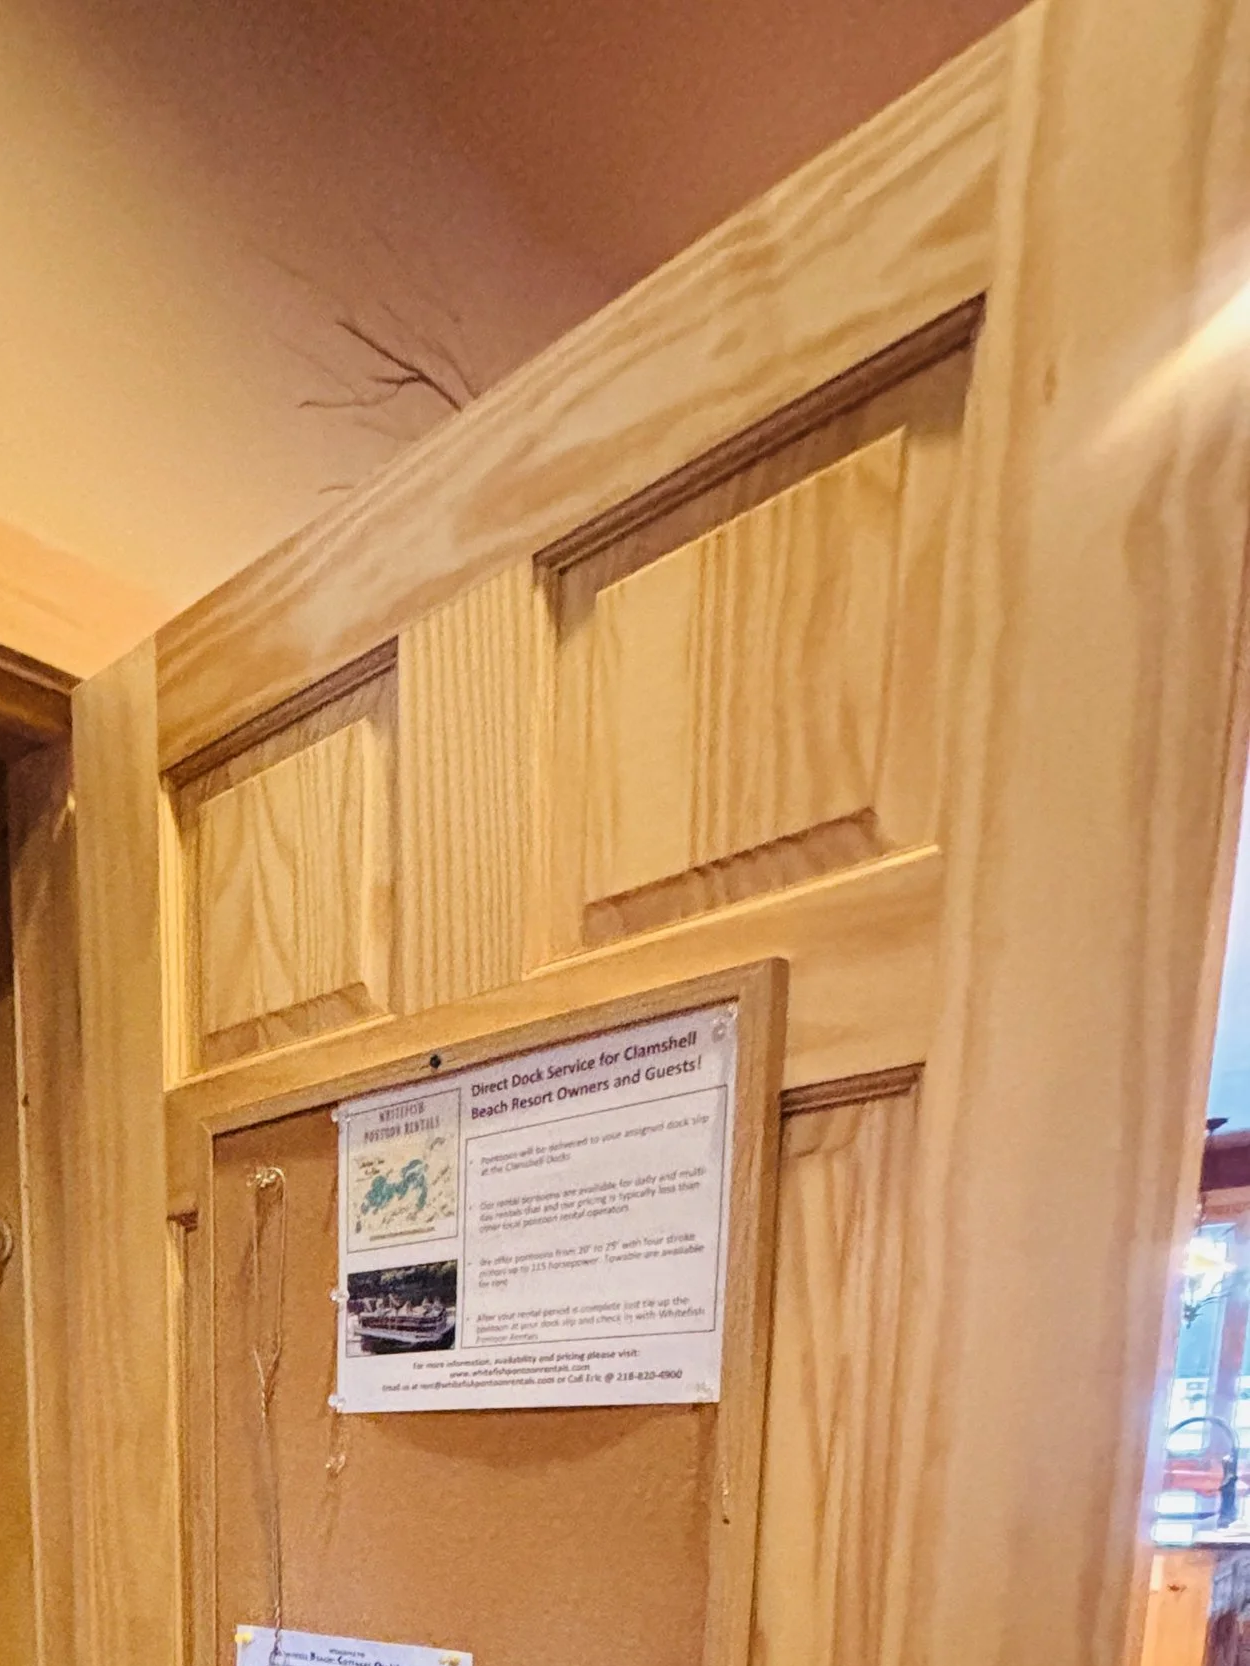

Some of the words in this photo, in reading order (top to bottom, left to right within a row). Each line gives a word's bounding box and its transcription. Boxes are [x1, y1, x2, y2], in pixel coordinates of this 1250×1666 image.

[471, 1079, 508, 1097] Direct
[511, 1070, 543, 1088] Dock
[546, 1057, 595, 1080] Service
[598, 1051, 620, 1067] for
[623, 1031, 697, 1062] Clamshell
[471, 1101, 508, 1119] Beach
[512, 1091, 553, 1110] Resort
[557, 1080, 609, 1100] Owners
[613, 1069, 640, 1088] and
[644, 1055, 703, 1081] Guests!
[539, 1352, 555, 1363] and
[556, 1351, 586, 1363] pricing
[586, 1349, 616, 1361] please
